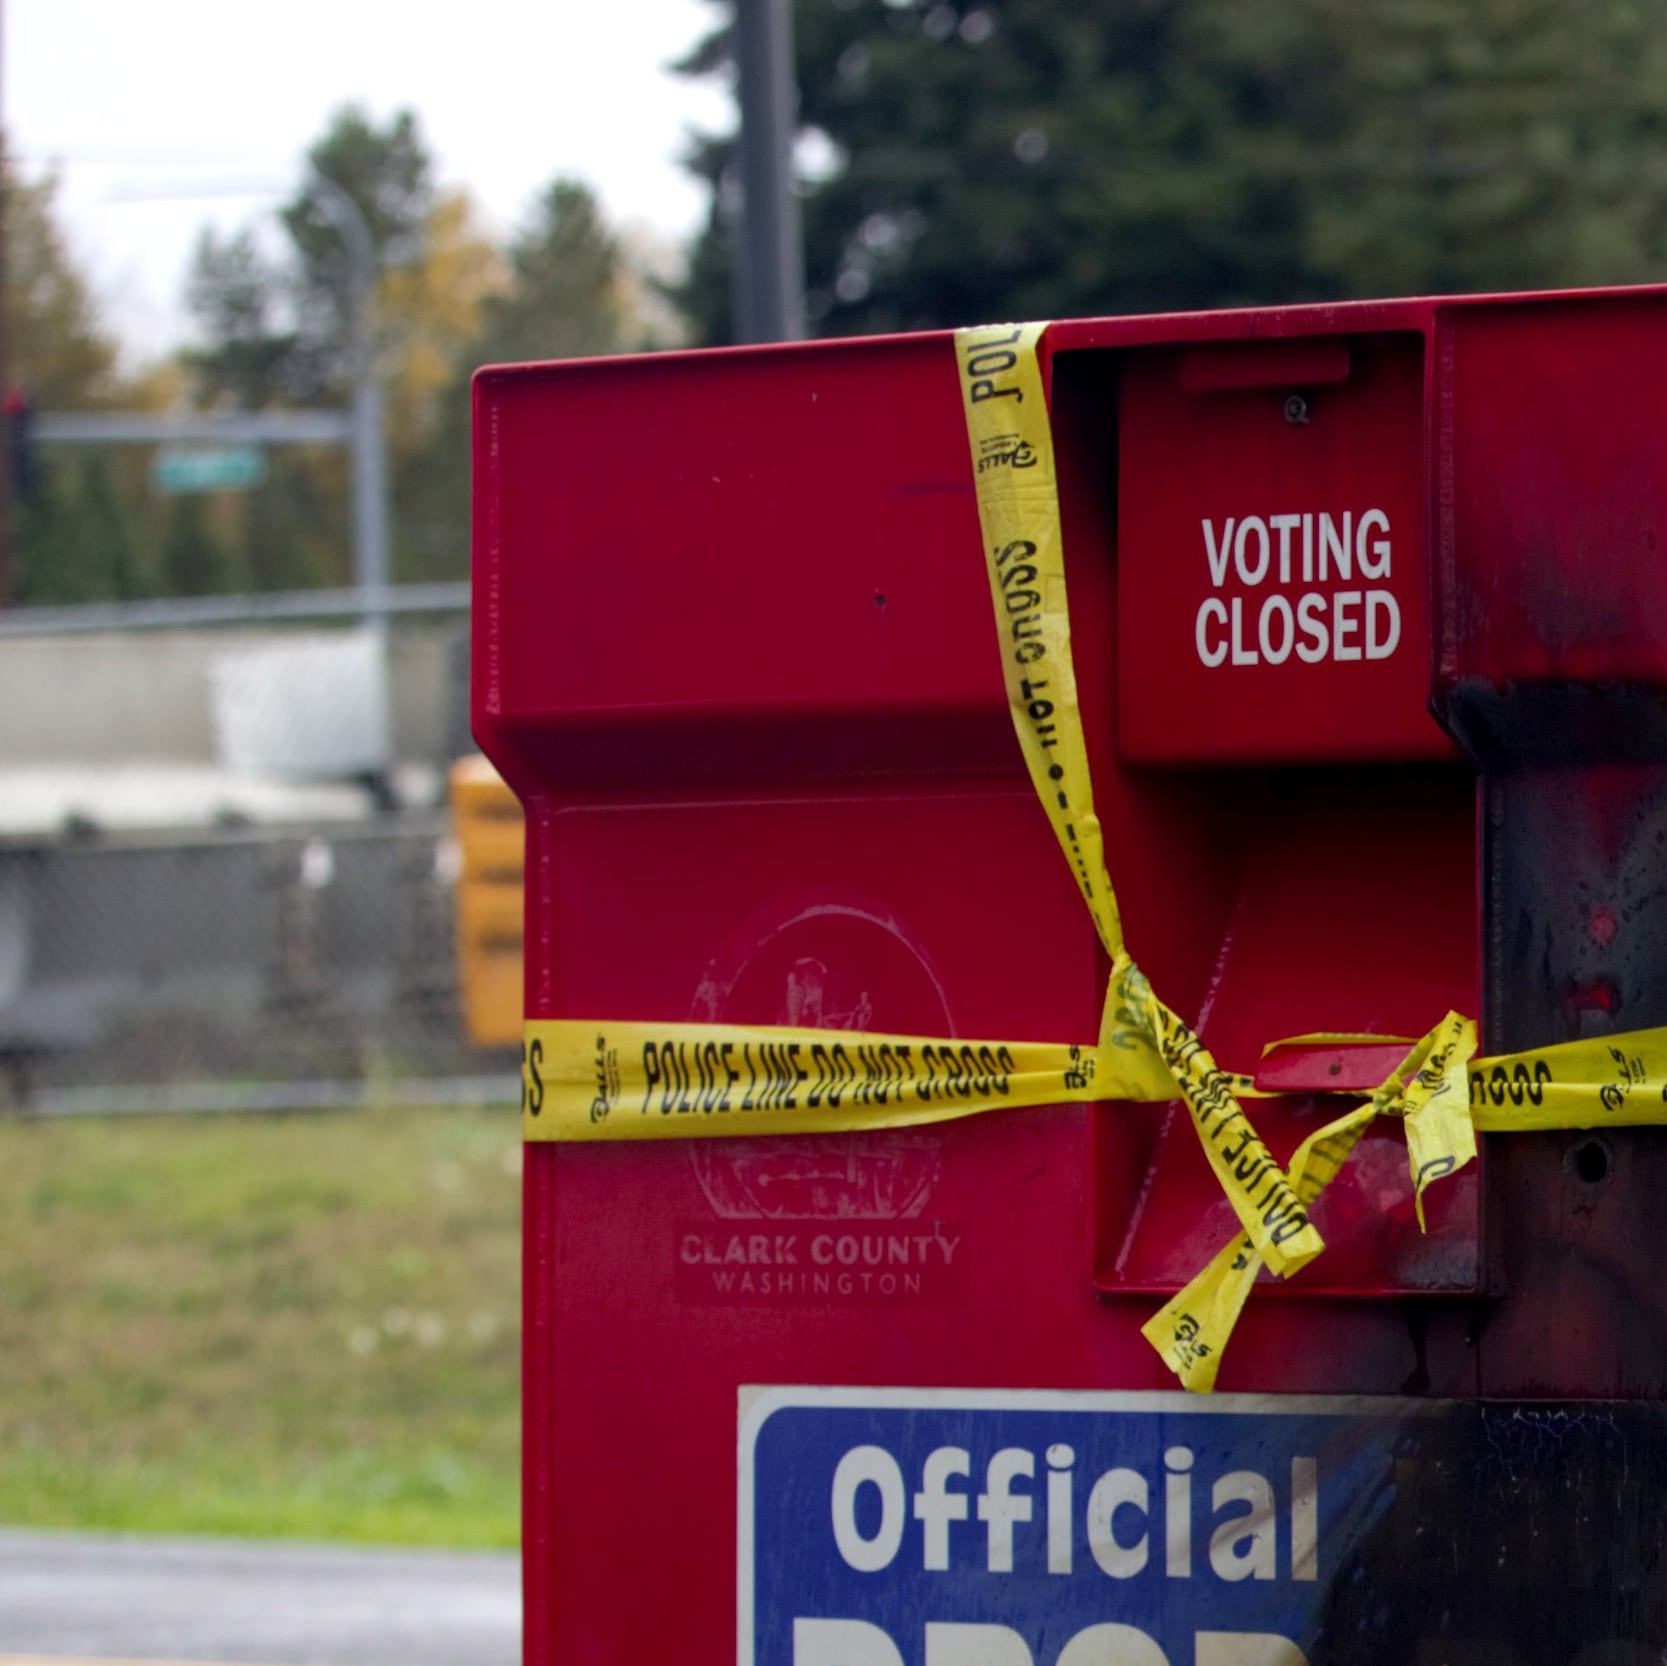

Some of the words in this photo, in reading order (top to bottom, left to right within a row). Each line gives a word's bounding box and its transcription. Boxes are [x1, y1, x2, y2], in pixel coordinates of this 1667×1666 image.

[1202, 508, 1391, 587] VOTING
[1195, 589, 1401, 668] CLOSED
[642, 1041, 739, 1115] POLICE
[741, 1043, 808, 1111] LINE
[808, 1043, 855, 1108] DO
[680, 1234, 799, 1265] CLARK
[810, 1234, 961, 1265] COUNTY
[712, 1271, 921, 1295] WASHINGTON
[831, 1444, 1319, 1582] Official
